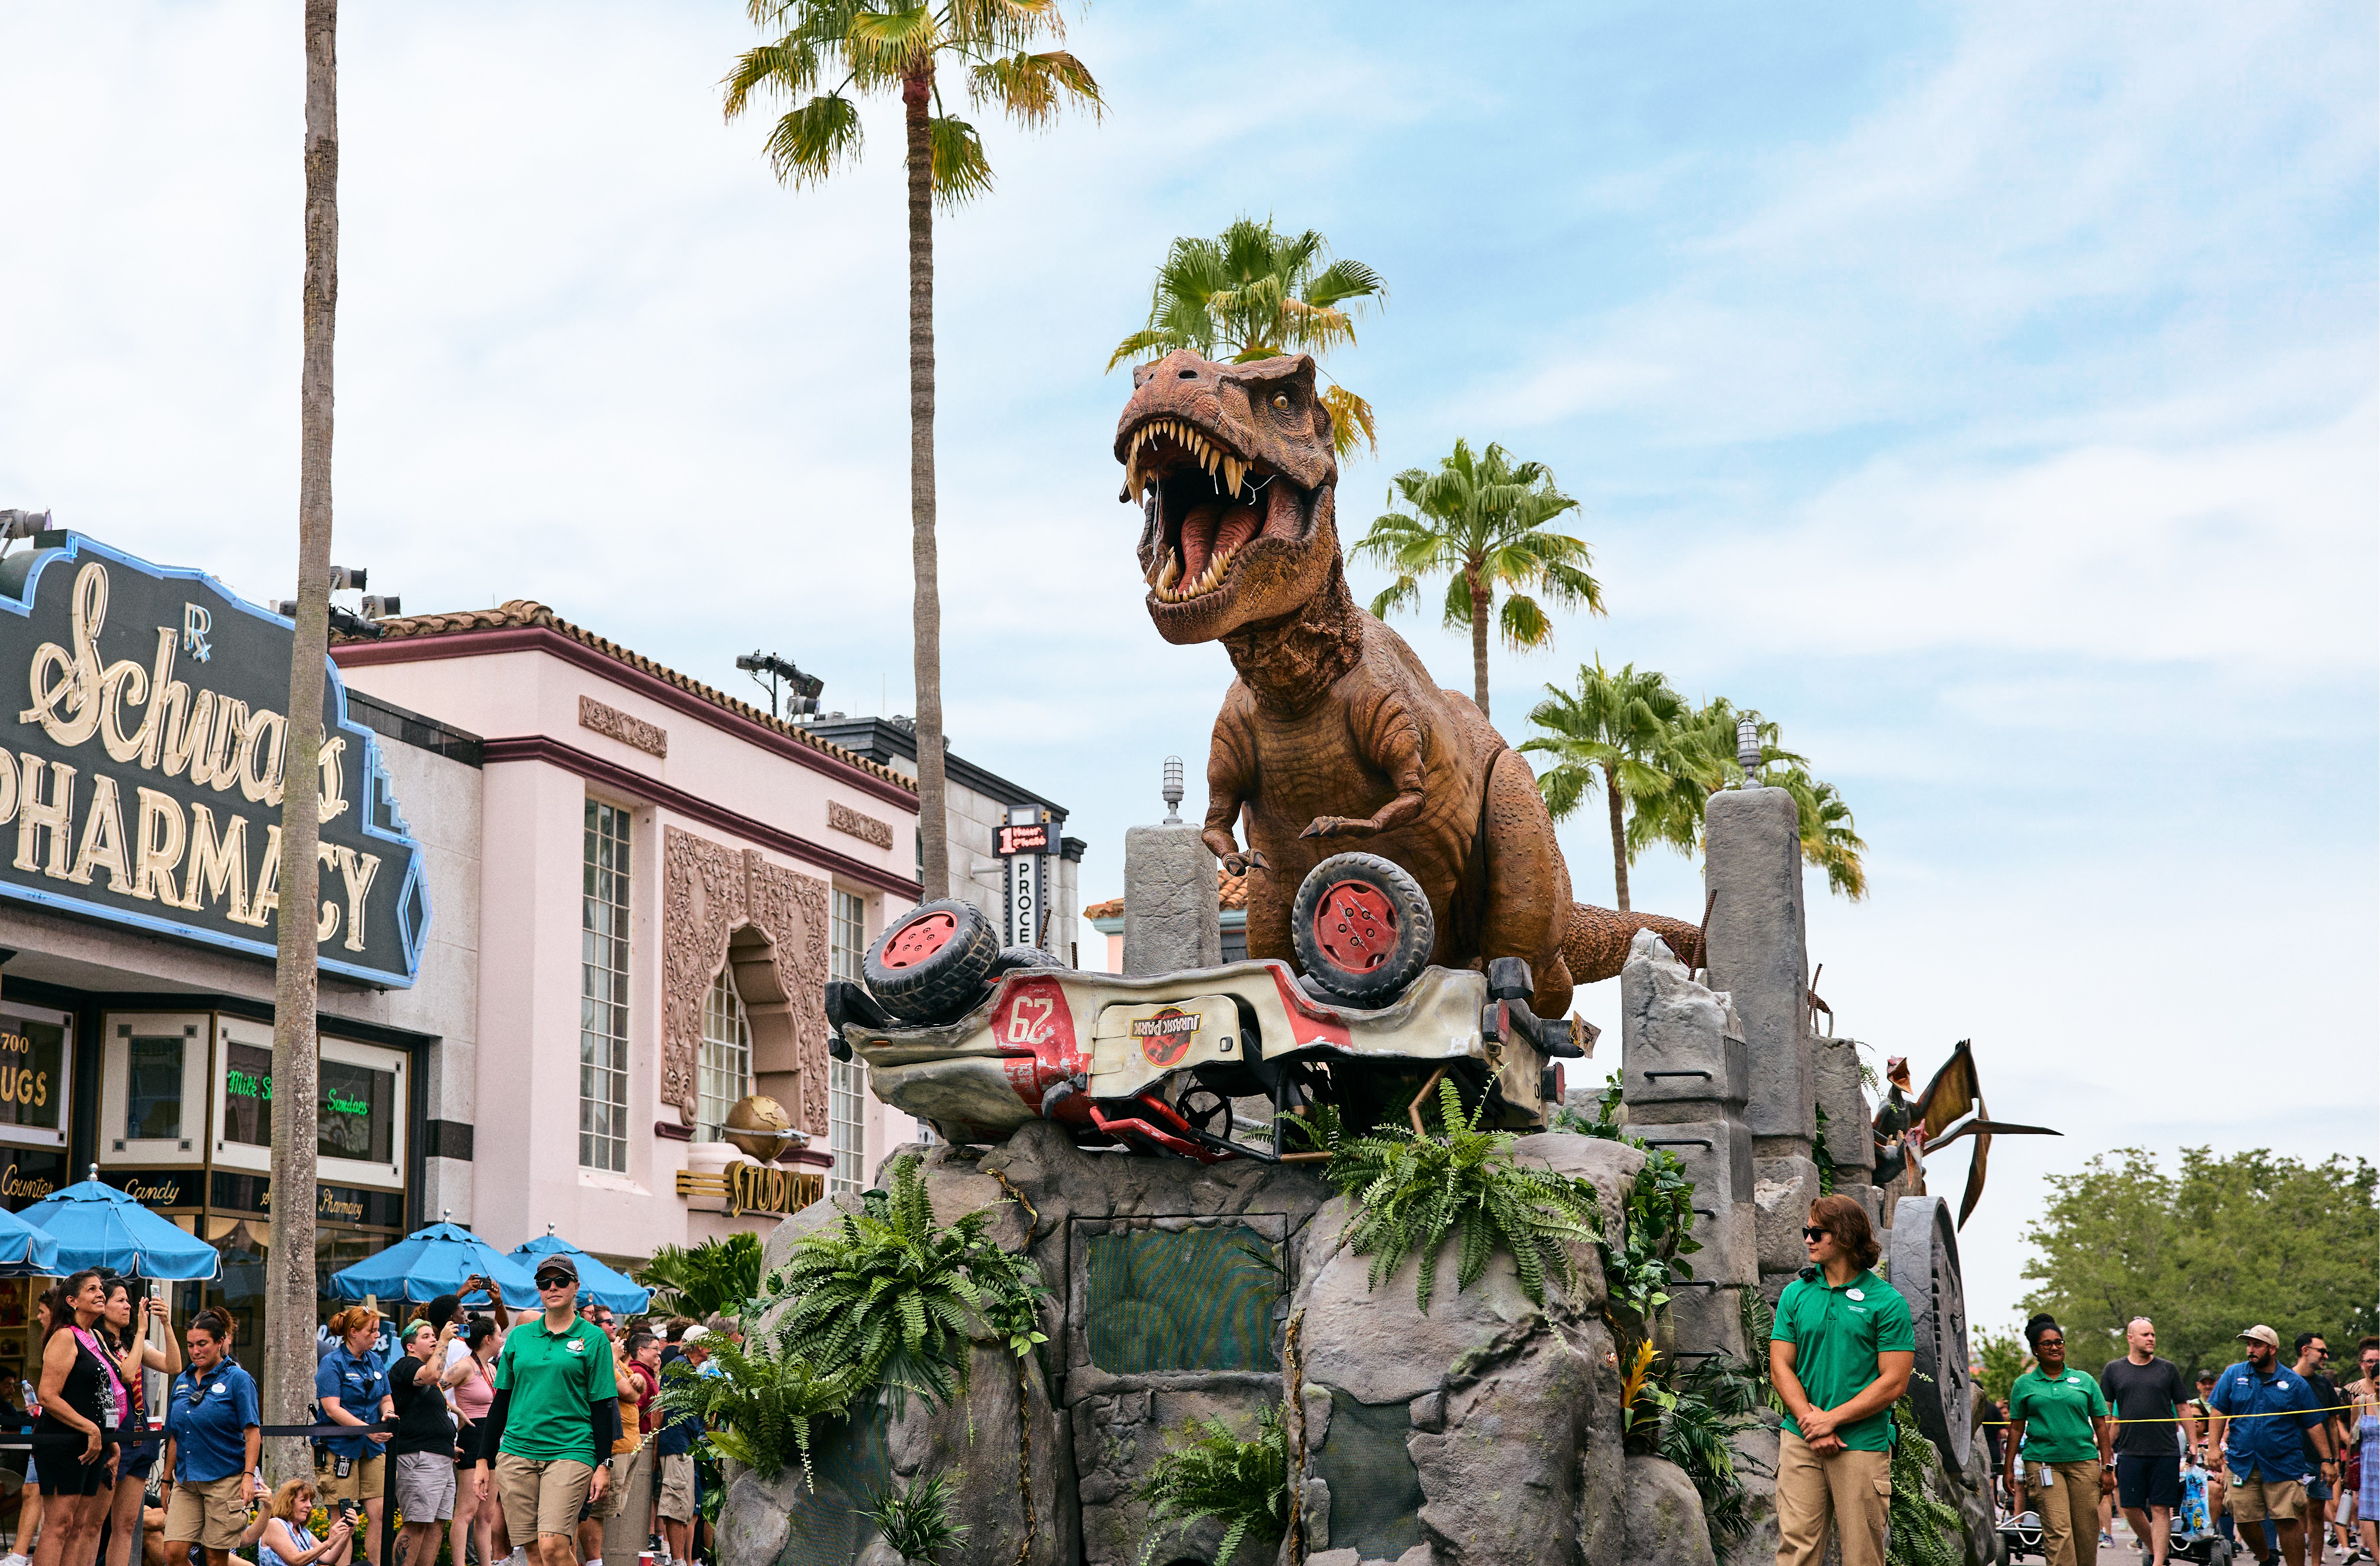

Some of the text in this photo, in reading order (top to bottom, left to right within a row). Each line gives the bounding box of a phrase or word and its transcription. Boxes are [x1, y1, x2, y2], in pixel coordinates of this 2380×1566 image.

[1018, 863, 1031, 947] PROCE
[1134, 1015, 1200, 1036] JURASSIC PARK
[227, 1070, 257, 1097] Milk
[327, 1088, 368, 1116] Sundaes
[2, 1164, 54, 1198] Counter
[125, 1178, 180, 1205] Candy
[732, 1160, 803, 1218] STUDIO
[319, 1188, 363, 1220] Pharmacy
